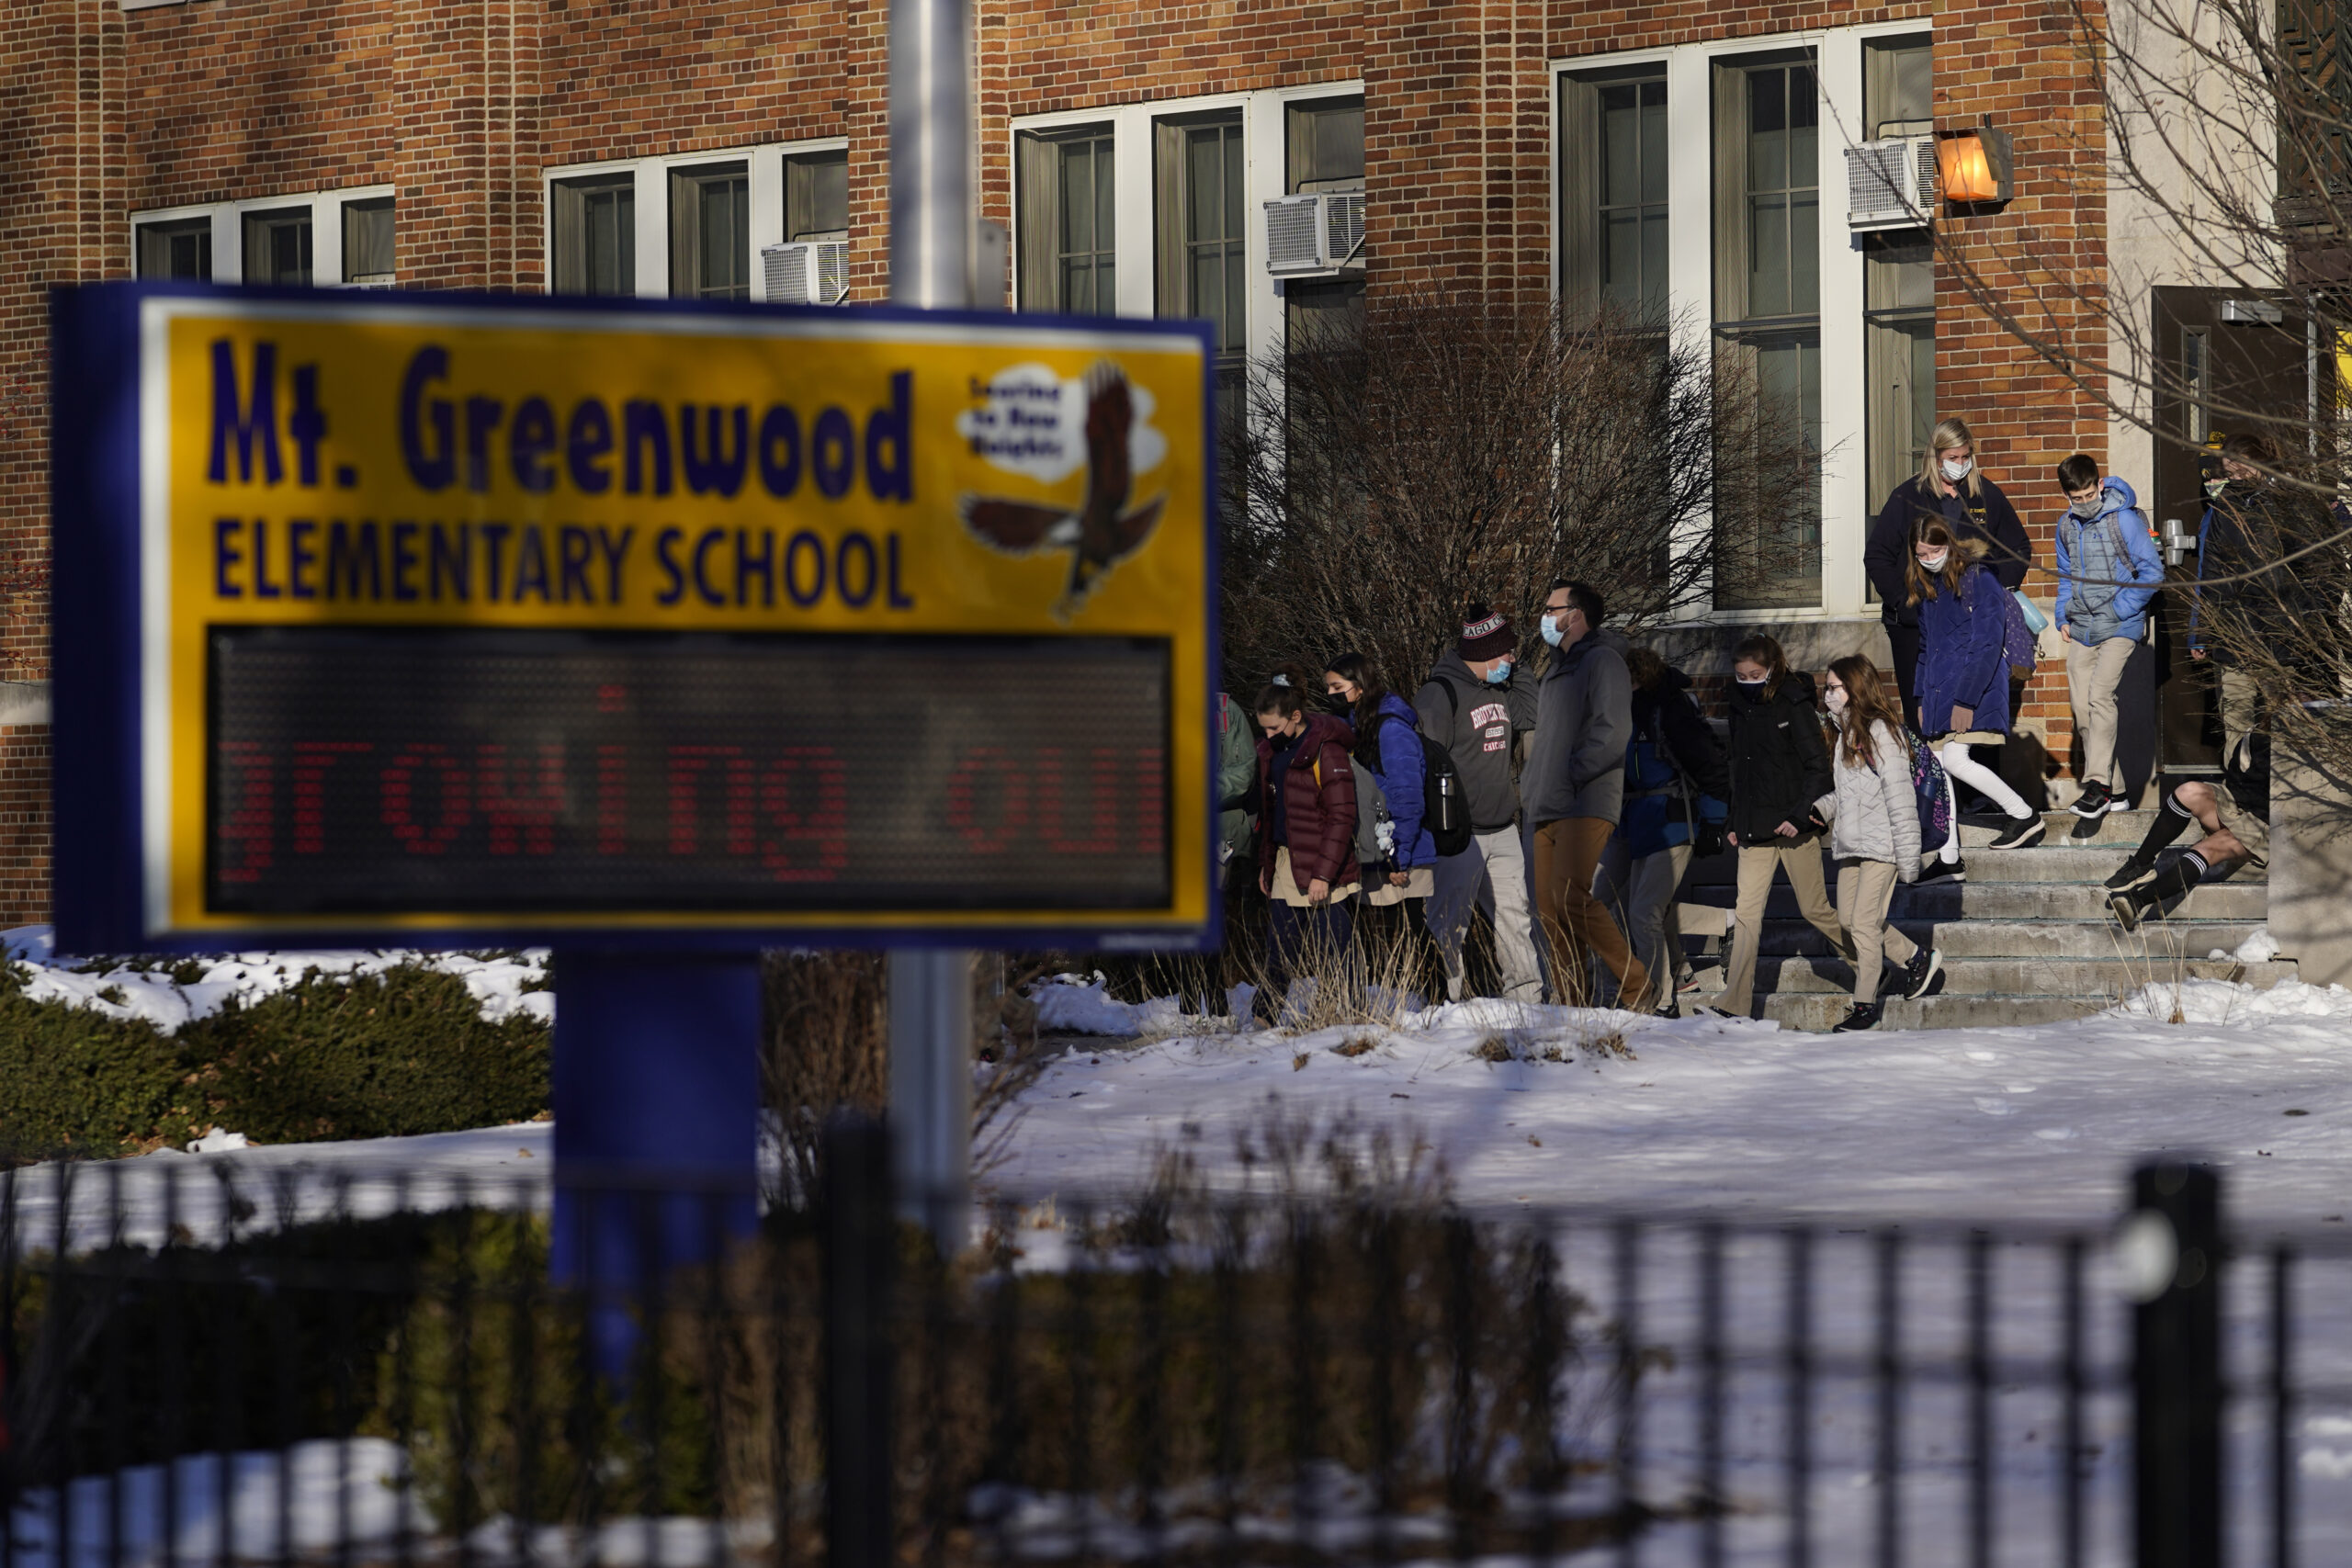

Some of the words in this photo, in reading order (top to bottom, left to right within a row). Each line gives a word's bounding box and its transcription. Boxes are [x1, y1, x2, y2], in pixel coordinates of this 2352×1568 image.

[206, 337, 360, 489] Mt.
[400, 343, 915, 504] Greenwood
[213, 517, 636, 607] ELEMENTARY
[655, 525, 916, 611] SCHOOL
